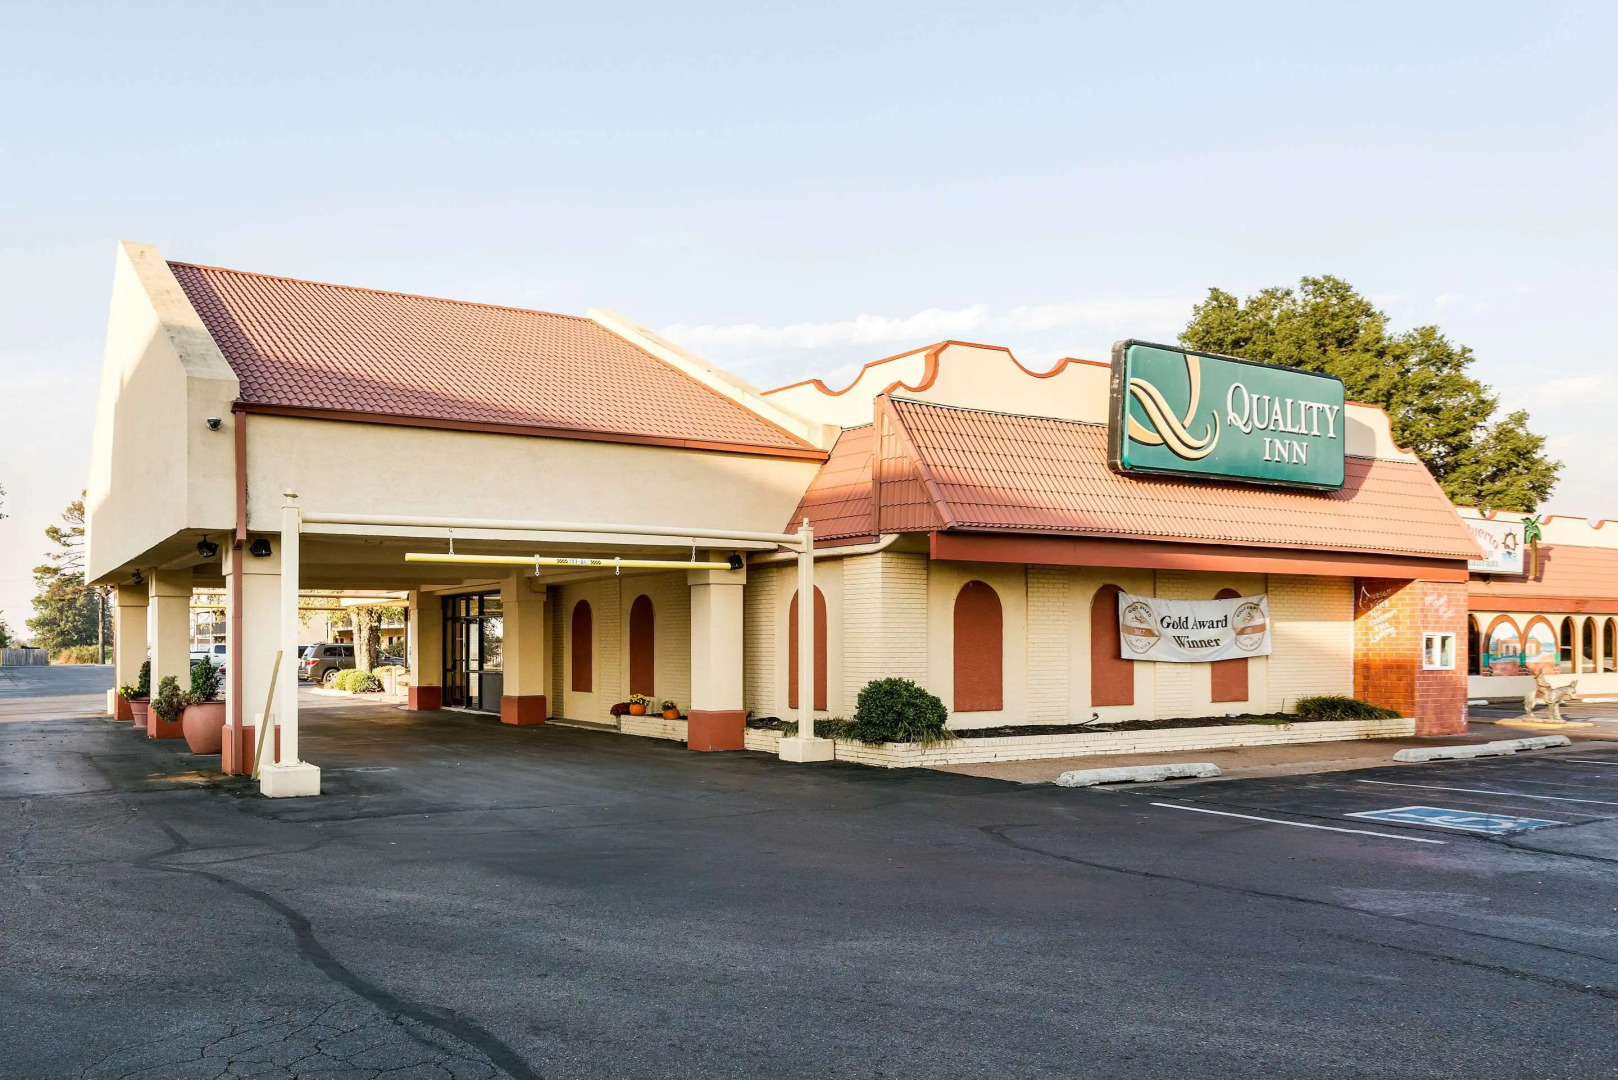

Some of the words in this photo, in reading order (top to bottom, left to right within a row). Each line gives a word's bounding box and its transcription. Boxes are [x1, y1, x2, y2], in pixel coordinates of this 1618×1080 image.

[1227, 382, 1340, 439] QUALITY
[1263, 437, 1309, 465] INN
[1160, 615, 1189, 630] Gold
[1191, 614, 1228, 629] Award
[1172, 635, 1221, 649] Winner
